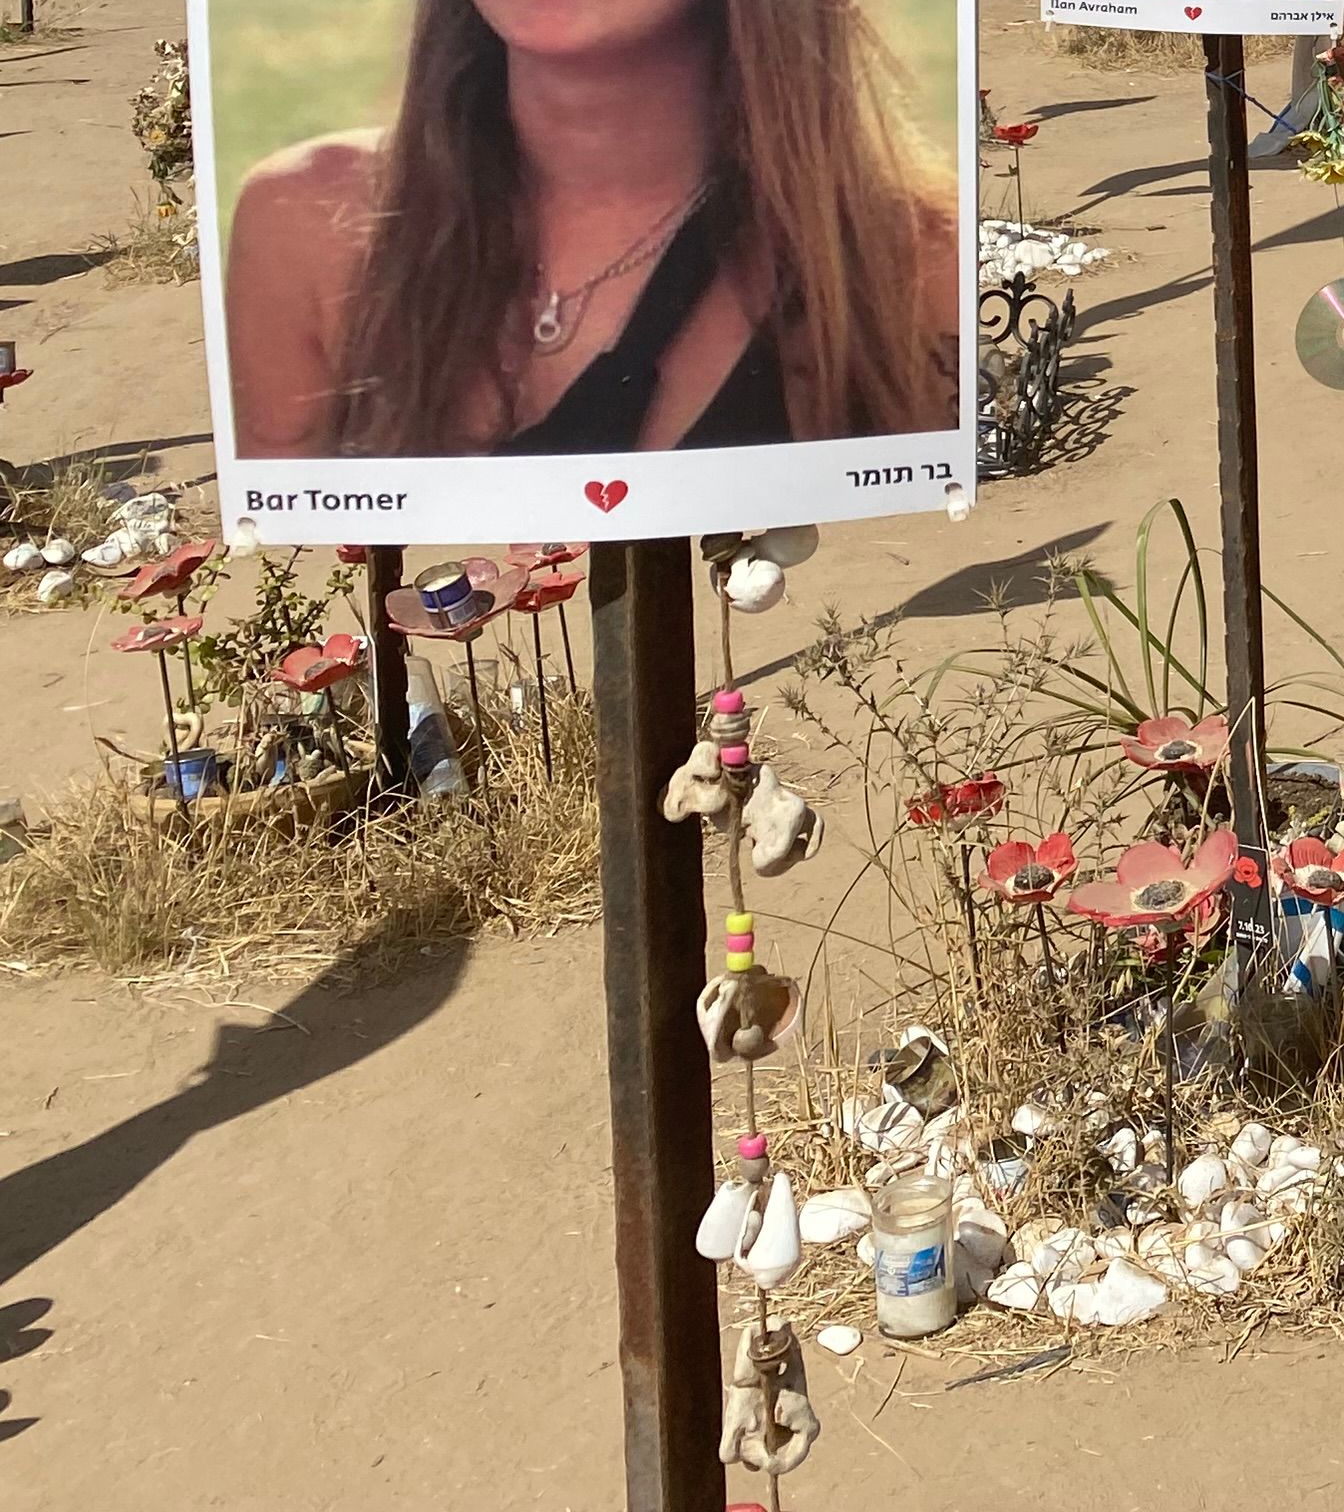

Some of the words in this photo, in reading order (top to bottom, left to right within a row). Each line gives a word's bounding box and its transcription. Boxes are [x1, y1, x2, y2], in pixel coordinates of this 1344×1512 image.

[1079, 0, 1138, 16] Avraham
[1270, 11, 1308, 22] אברהם
[1310, 11, 1335, 23] אילן
[846, 466, 913, 487] תומר
[921, 462, 953, 481] בר
[246, 489, 298, 511] Bar
[303, 489, 408, 511] Tomer
